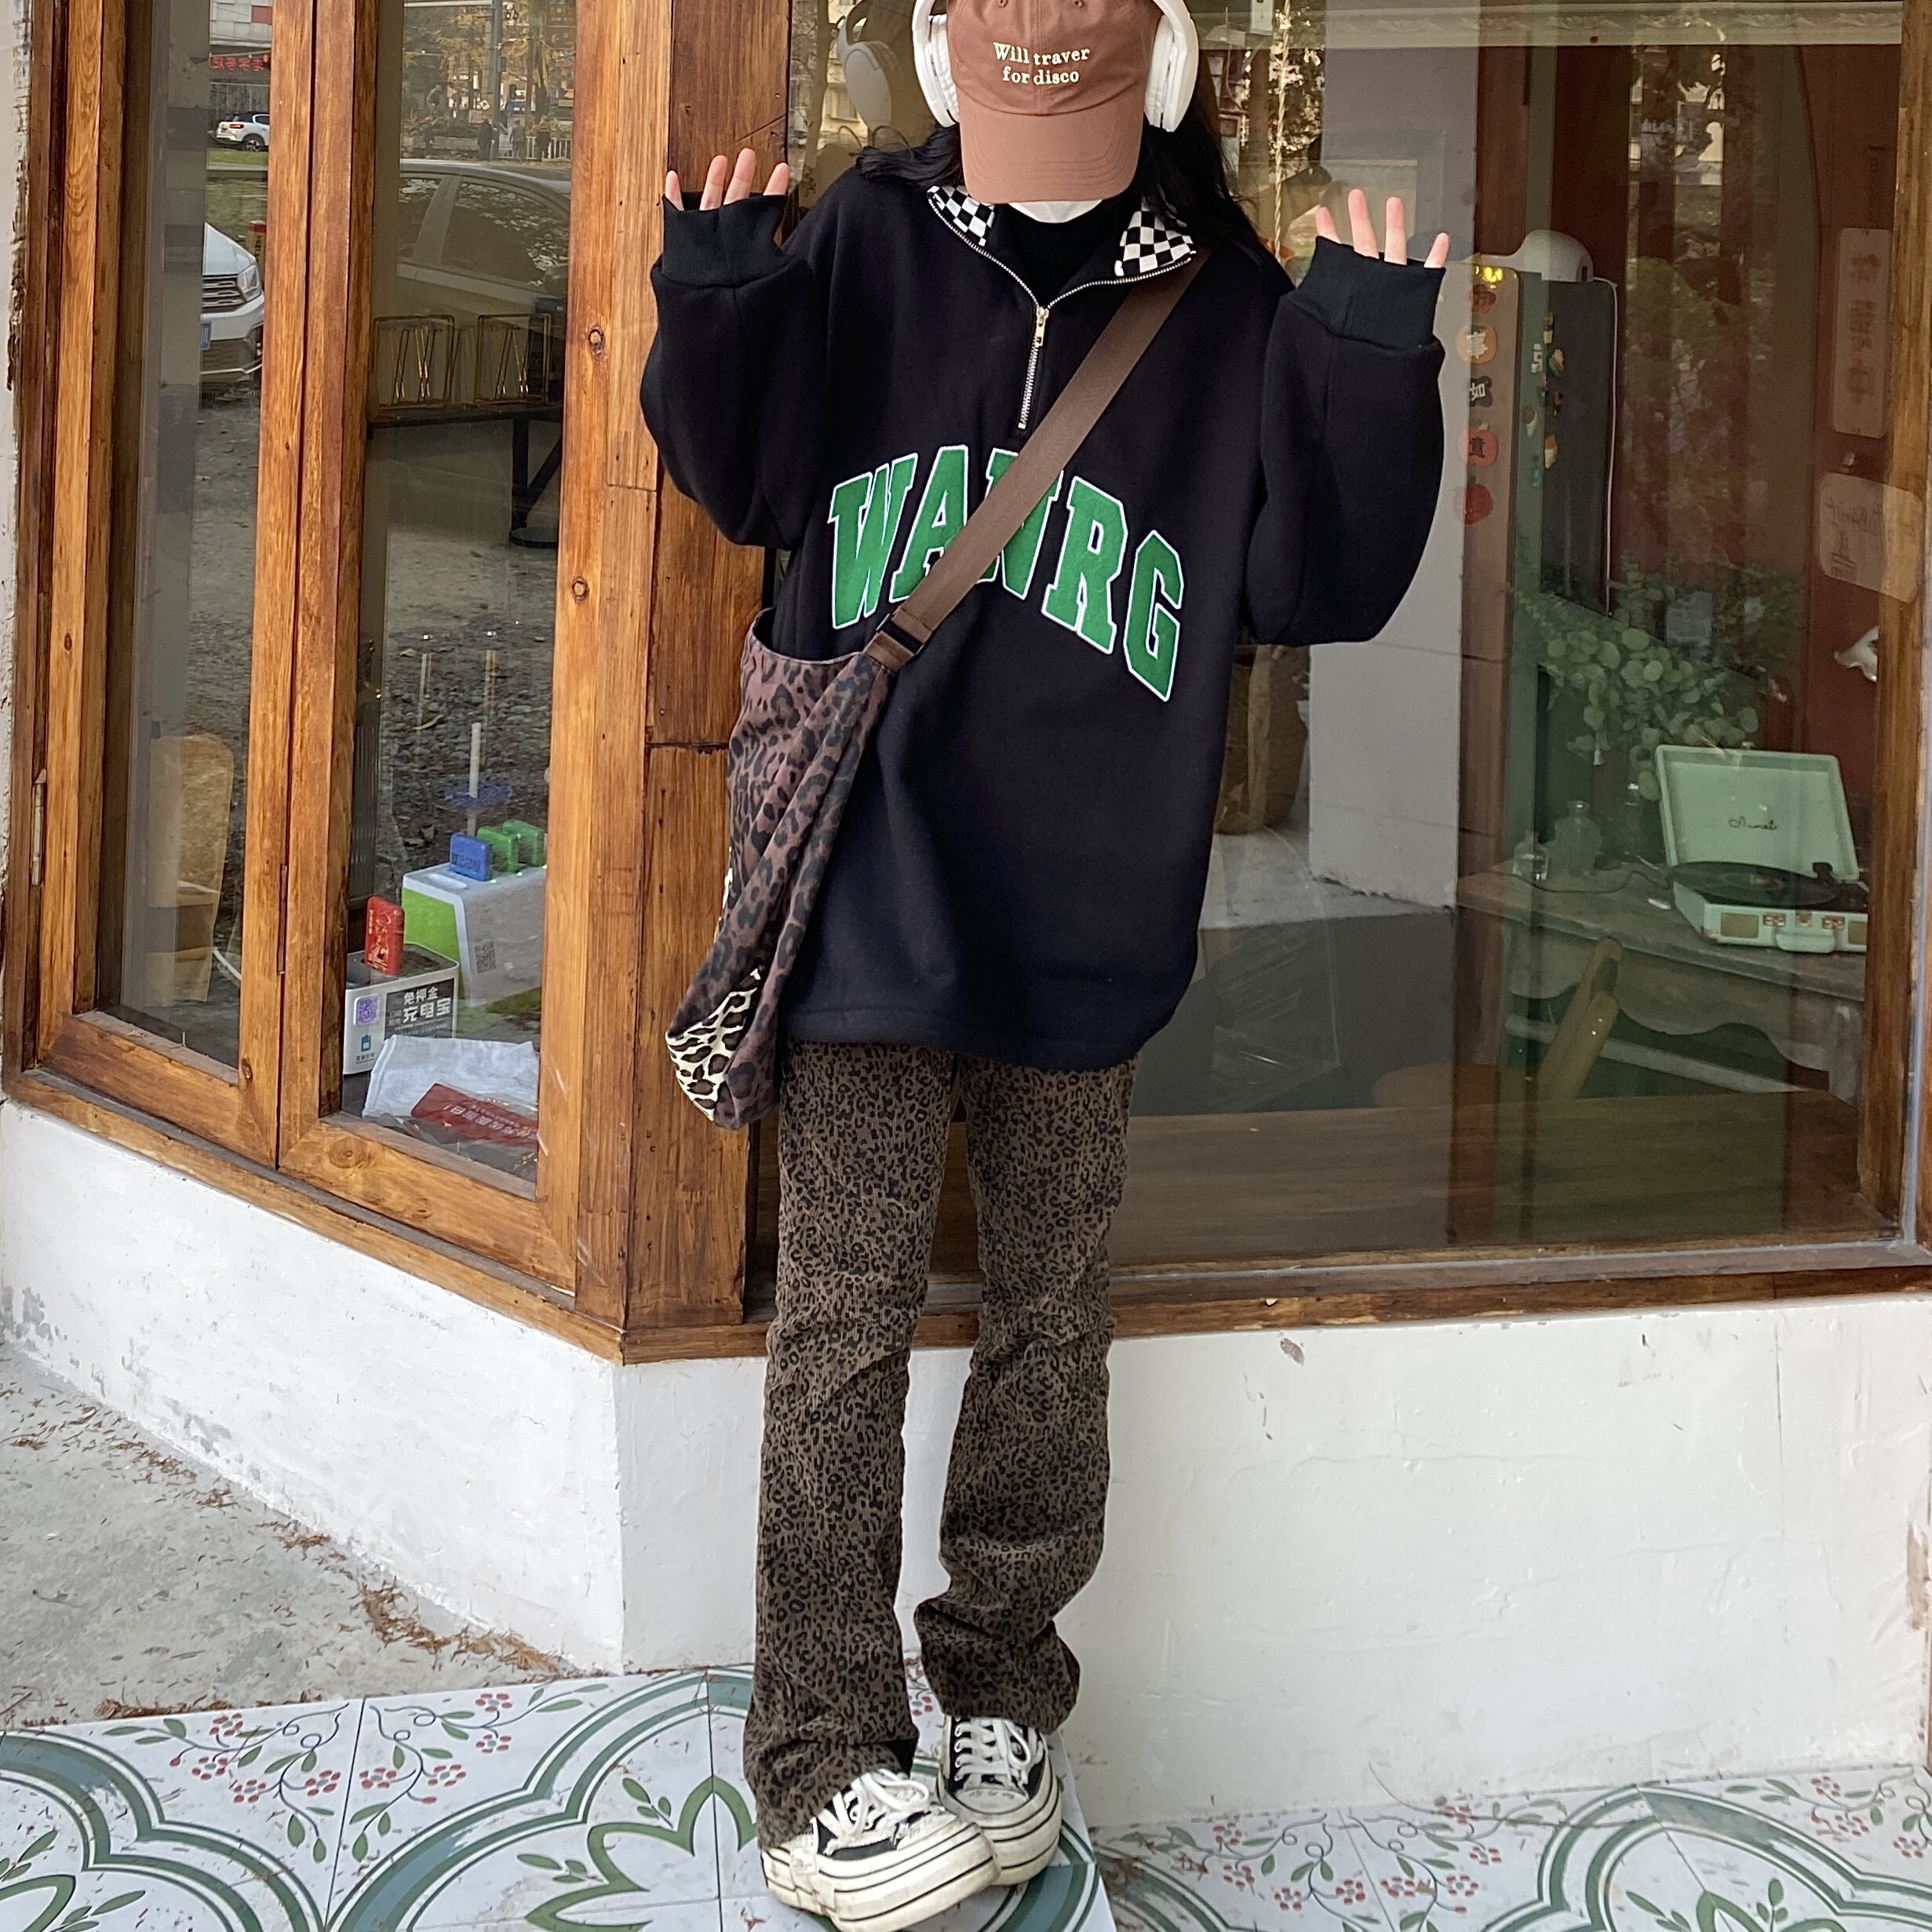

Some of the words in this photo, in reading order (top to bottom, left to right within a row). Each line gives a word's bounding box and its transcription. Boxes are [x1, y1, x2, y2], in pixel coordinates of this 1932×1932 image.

[993, 42, 1030, 64] Will
[1033, 48, 1090, 66] traver
[1002, 66, 1030, 85] for
[1033, 69, 1080, 86] disco
[403, 986, 439, 1006] 免押金
[403, 997, 451, 1023] 充电宝
